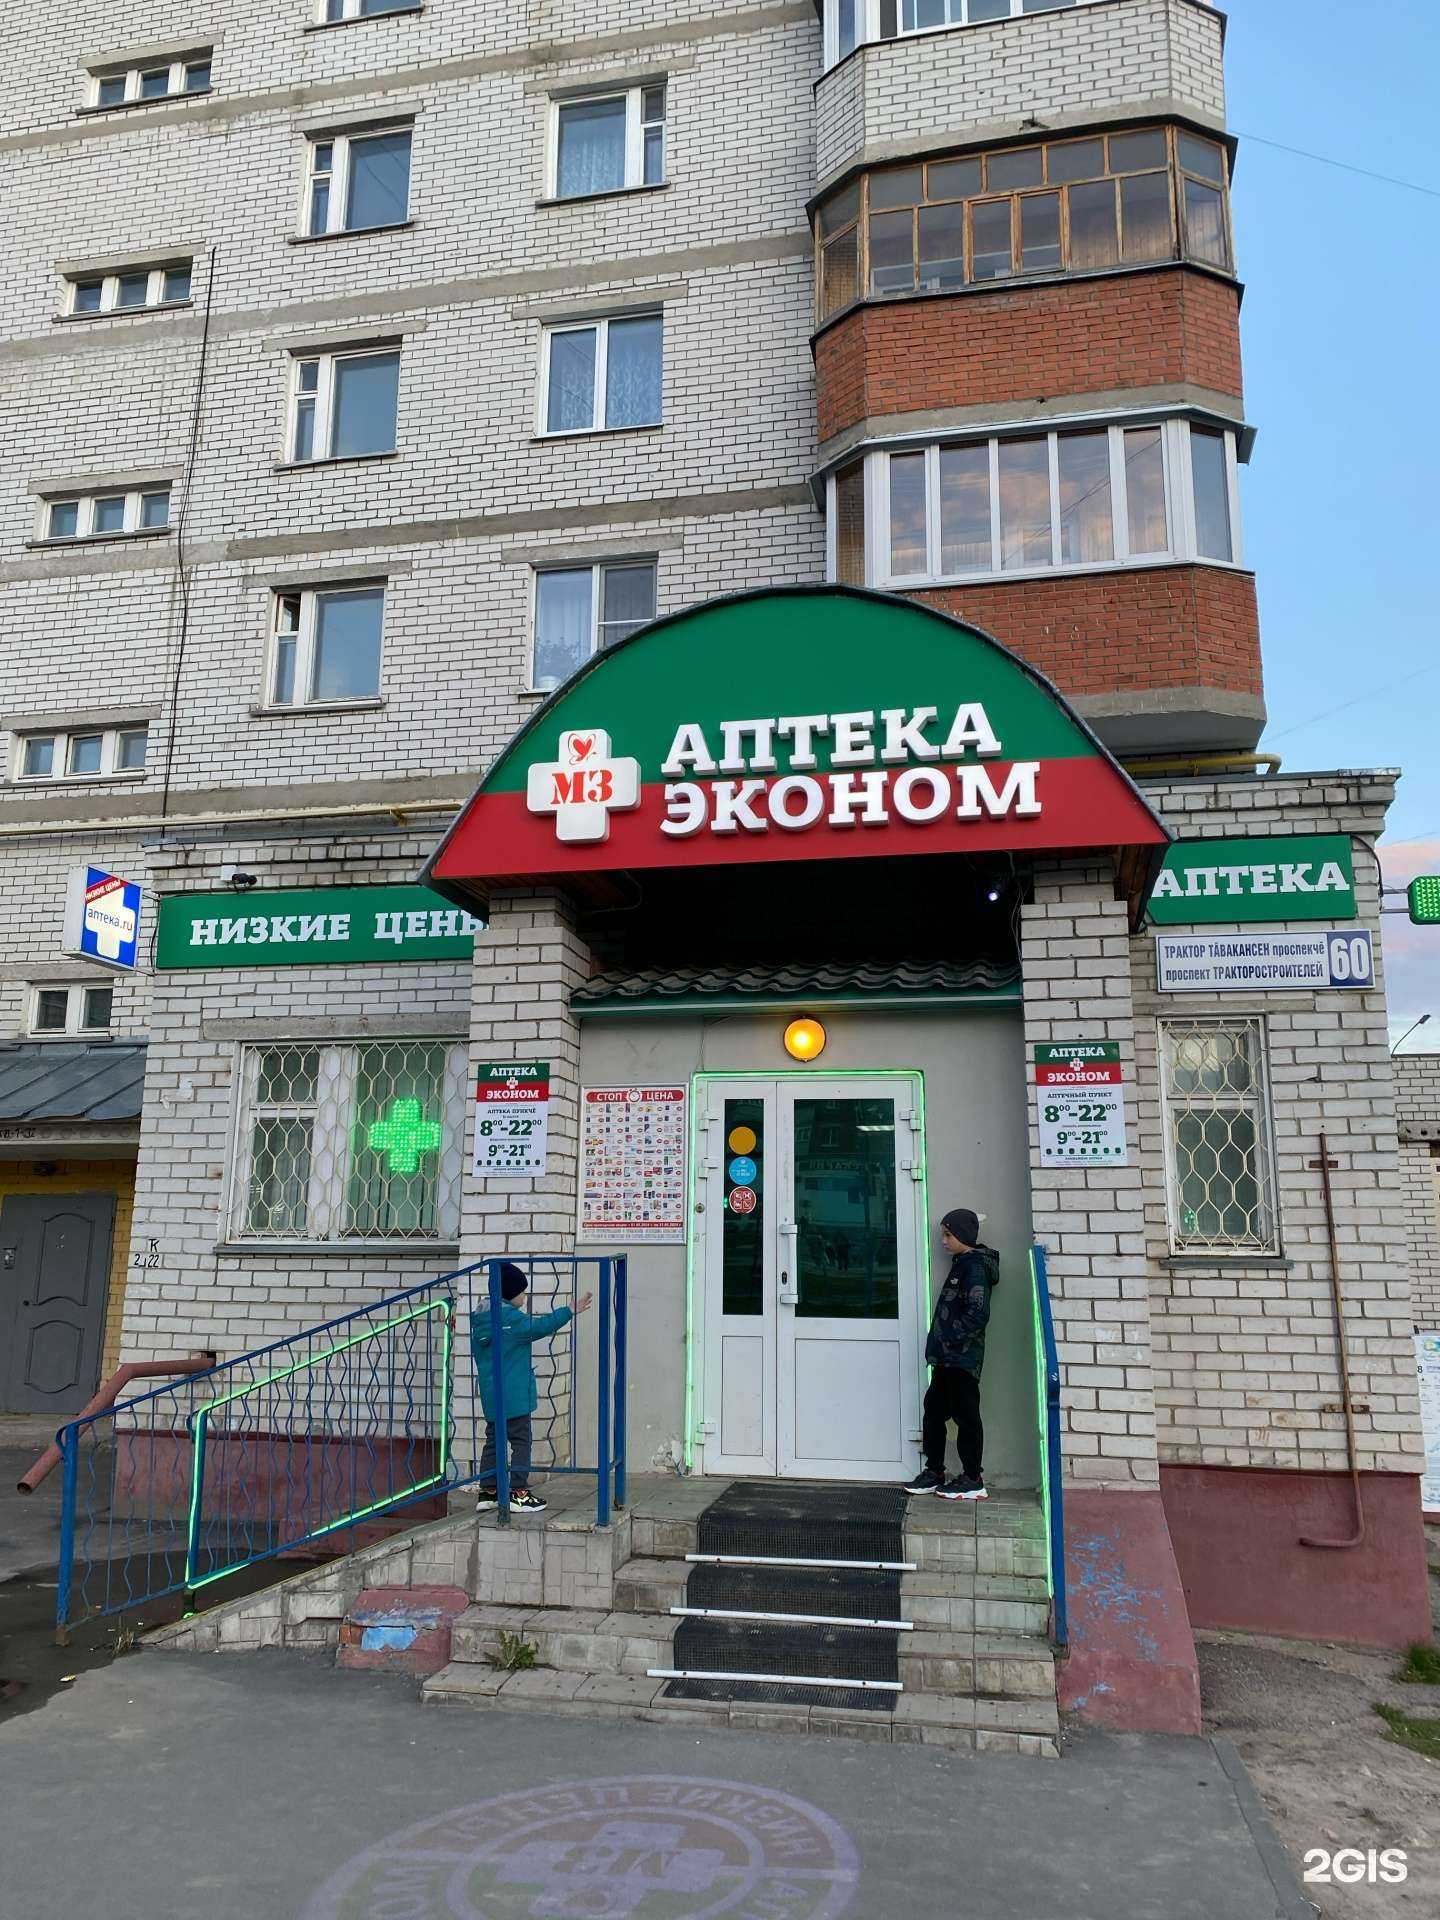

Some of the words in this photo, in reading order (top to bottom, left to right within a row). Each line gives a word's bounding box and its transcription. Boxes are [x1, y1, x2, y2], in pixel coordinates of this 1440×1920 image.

[661, 702, 1002, 778] АПТЕКА
[660, 762, 1042, 838] ЭКОНОМ
[1151, 861, 1350, 898] АПТЕКА
[87, 908, 133, 931] аптека.ru
[190, 913, 351, 946] НИЗКИЕ
[1164, 944, 1206, 958] ТРАКТОР
[1330, 937, 1371, 981] 60
[1165, 967, 1211, 982] проспект
[1212, 961, 1324, 979] ТРАКТОРОСТРОИТЕЛЕЙ
[1049, 1046, 1106, 1058] АПТЕКА
[489, 1066, 538, 1077] АПТЕКА
[1047, 1071, 1111, 1083] ЭКОНОМ
[486, 1089, 540, 1099] ЭКОНОМ
[597, 1091, 623, 1102] СТОП
[646, 1090, 674, 1101] ЦЕНА
